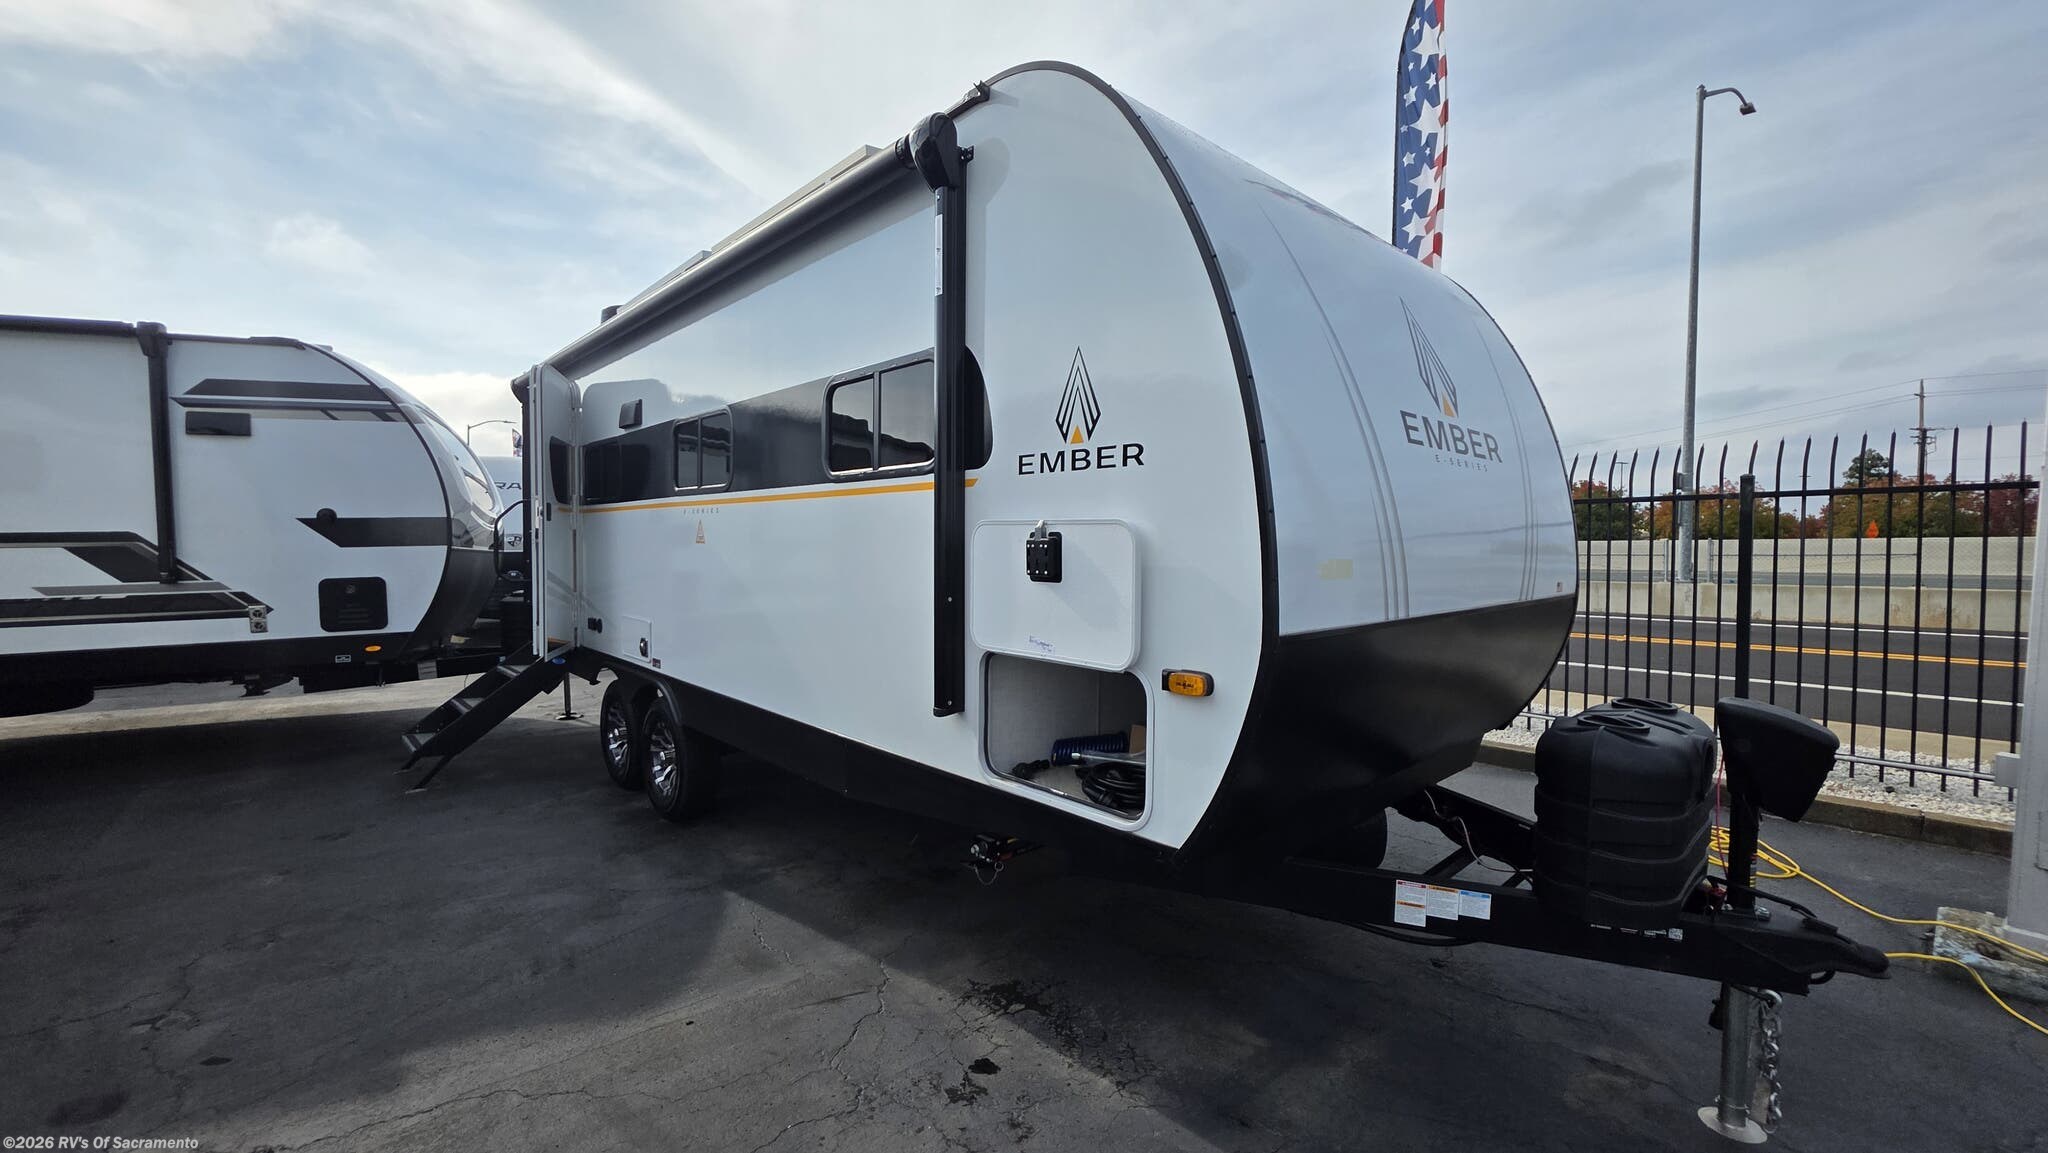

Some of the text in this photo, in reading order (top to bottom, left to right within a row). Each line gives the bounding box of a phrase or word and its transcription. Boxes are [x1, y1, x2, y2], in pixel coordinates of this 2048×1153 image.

[1399, 409, 1503, 463] EMBER
[1018, 442, 1145, 476] EMBER
[1434, 454, 1489, 473] E-SERIES
